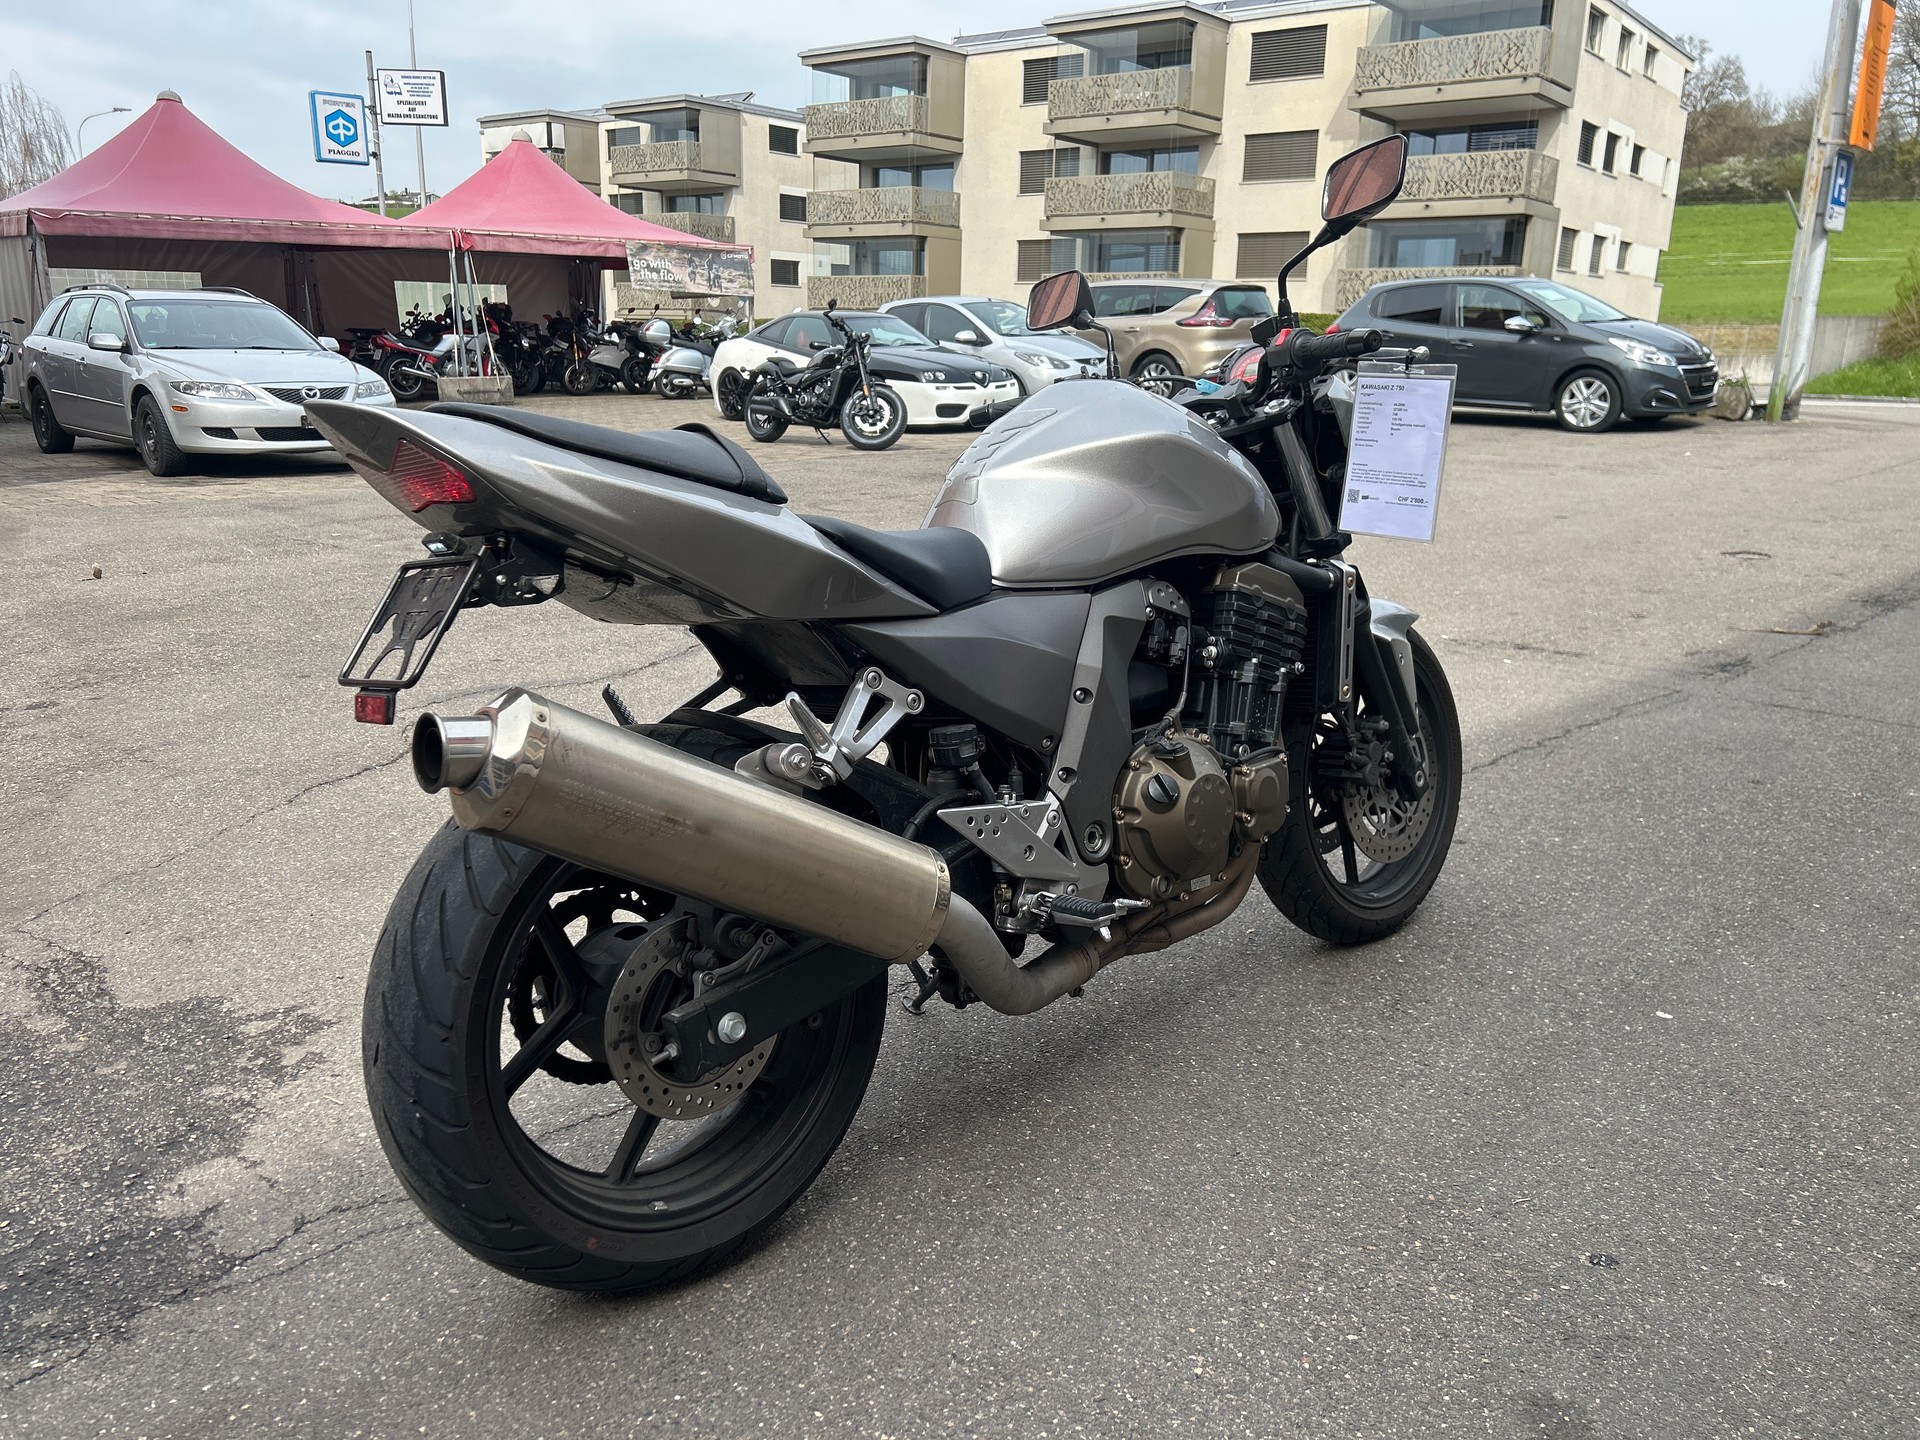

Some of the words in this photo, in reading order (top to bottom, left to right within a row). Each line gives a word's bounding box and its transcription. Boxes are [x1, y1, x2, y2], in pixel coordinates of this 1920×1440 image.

[328, 149, 360, 157] PIAGGIO
[633, 259, 647, 270] go
[648, 258, 672, 269] with
[640, 268, 658, 280] the
[660, 269, 683, 281] flow
